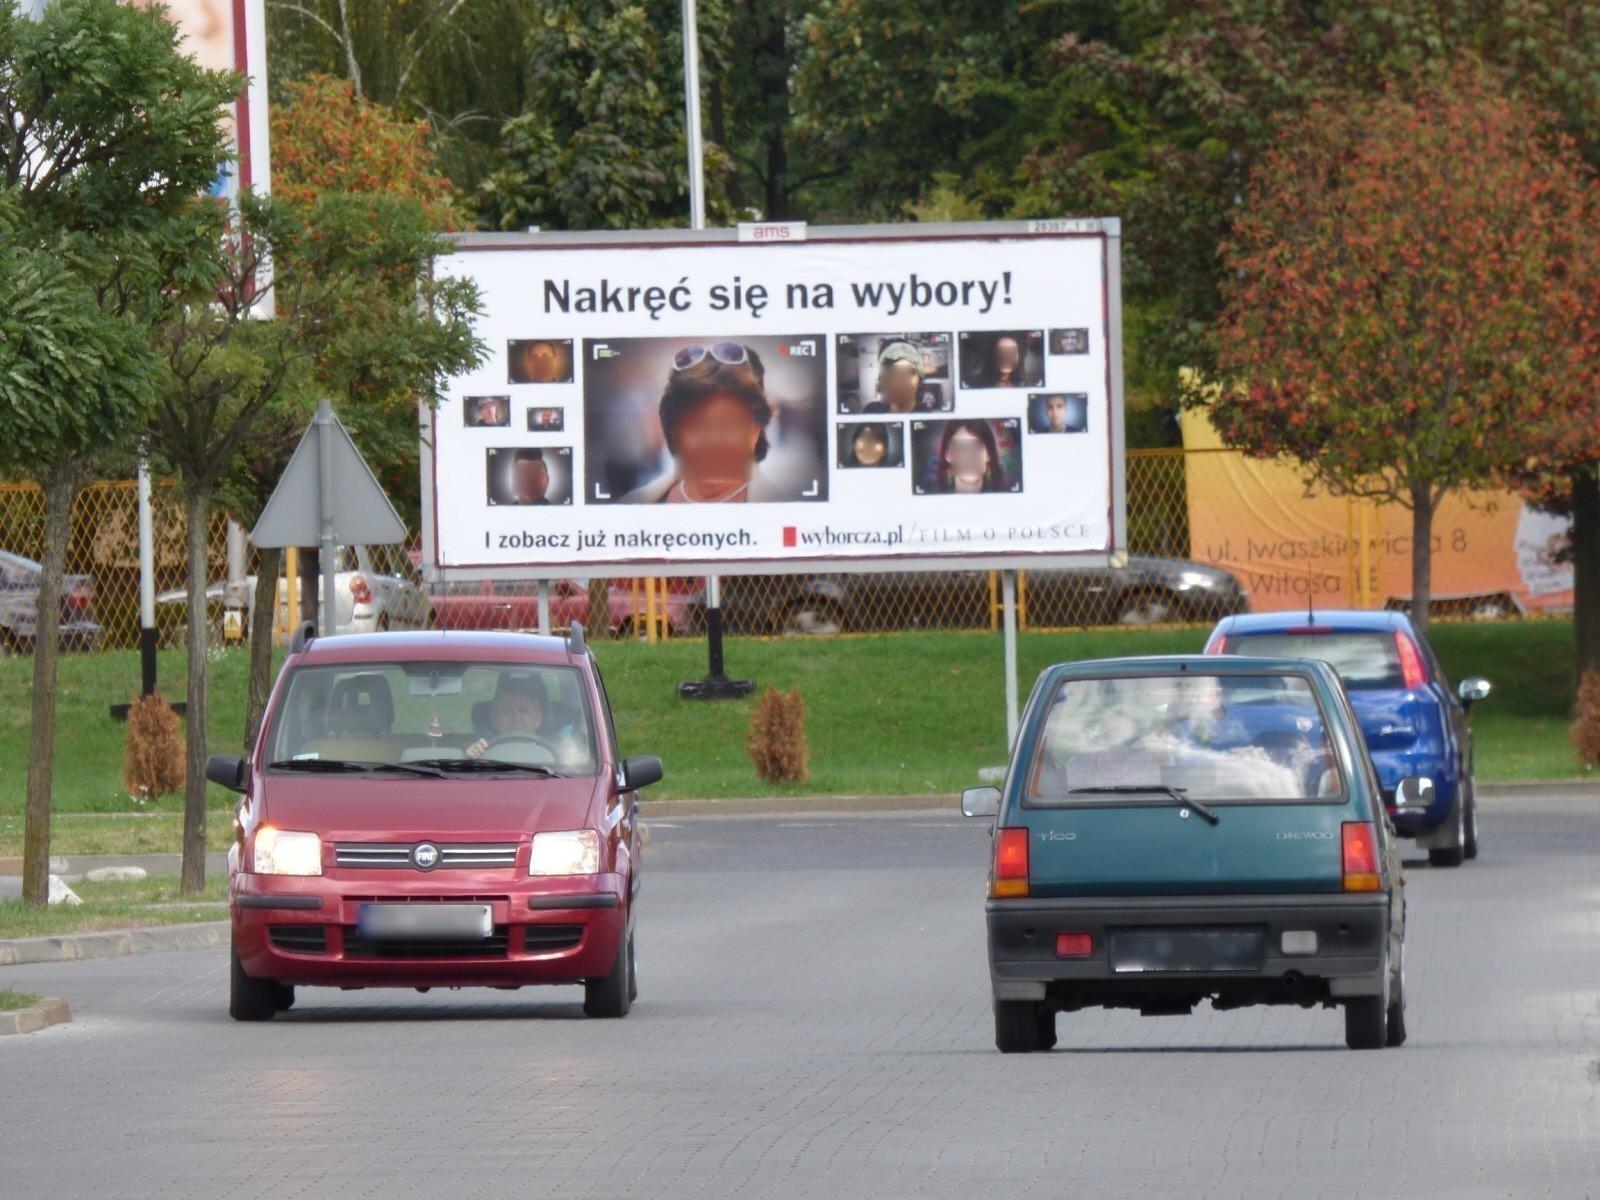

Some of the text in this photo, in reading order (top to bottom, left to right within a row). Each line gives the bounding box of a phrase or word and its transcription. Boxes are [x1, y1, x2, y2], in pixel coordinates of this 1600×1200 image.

[753, 226, 790, 238] ams
[543, 271, 1012, 321] Nakręć się na wybory!
[790, 346, 810, 356] REC
[485, 529, 758, 551] I zobacz już nakręconych.
[983, 527, 995, 540] O
[1008, 524, 1089, 540] POLSCE
[1207, 538, 1237, 562] ul.
[1452, 528, 1467, 553] 8
[1248, 570, 1341, 595] Witosa
